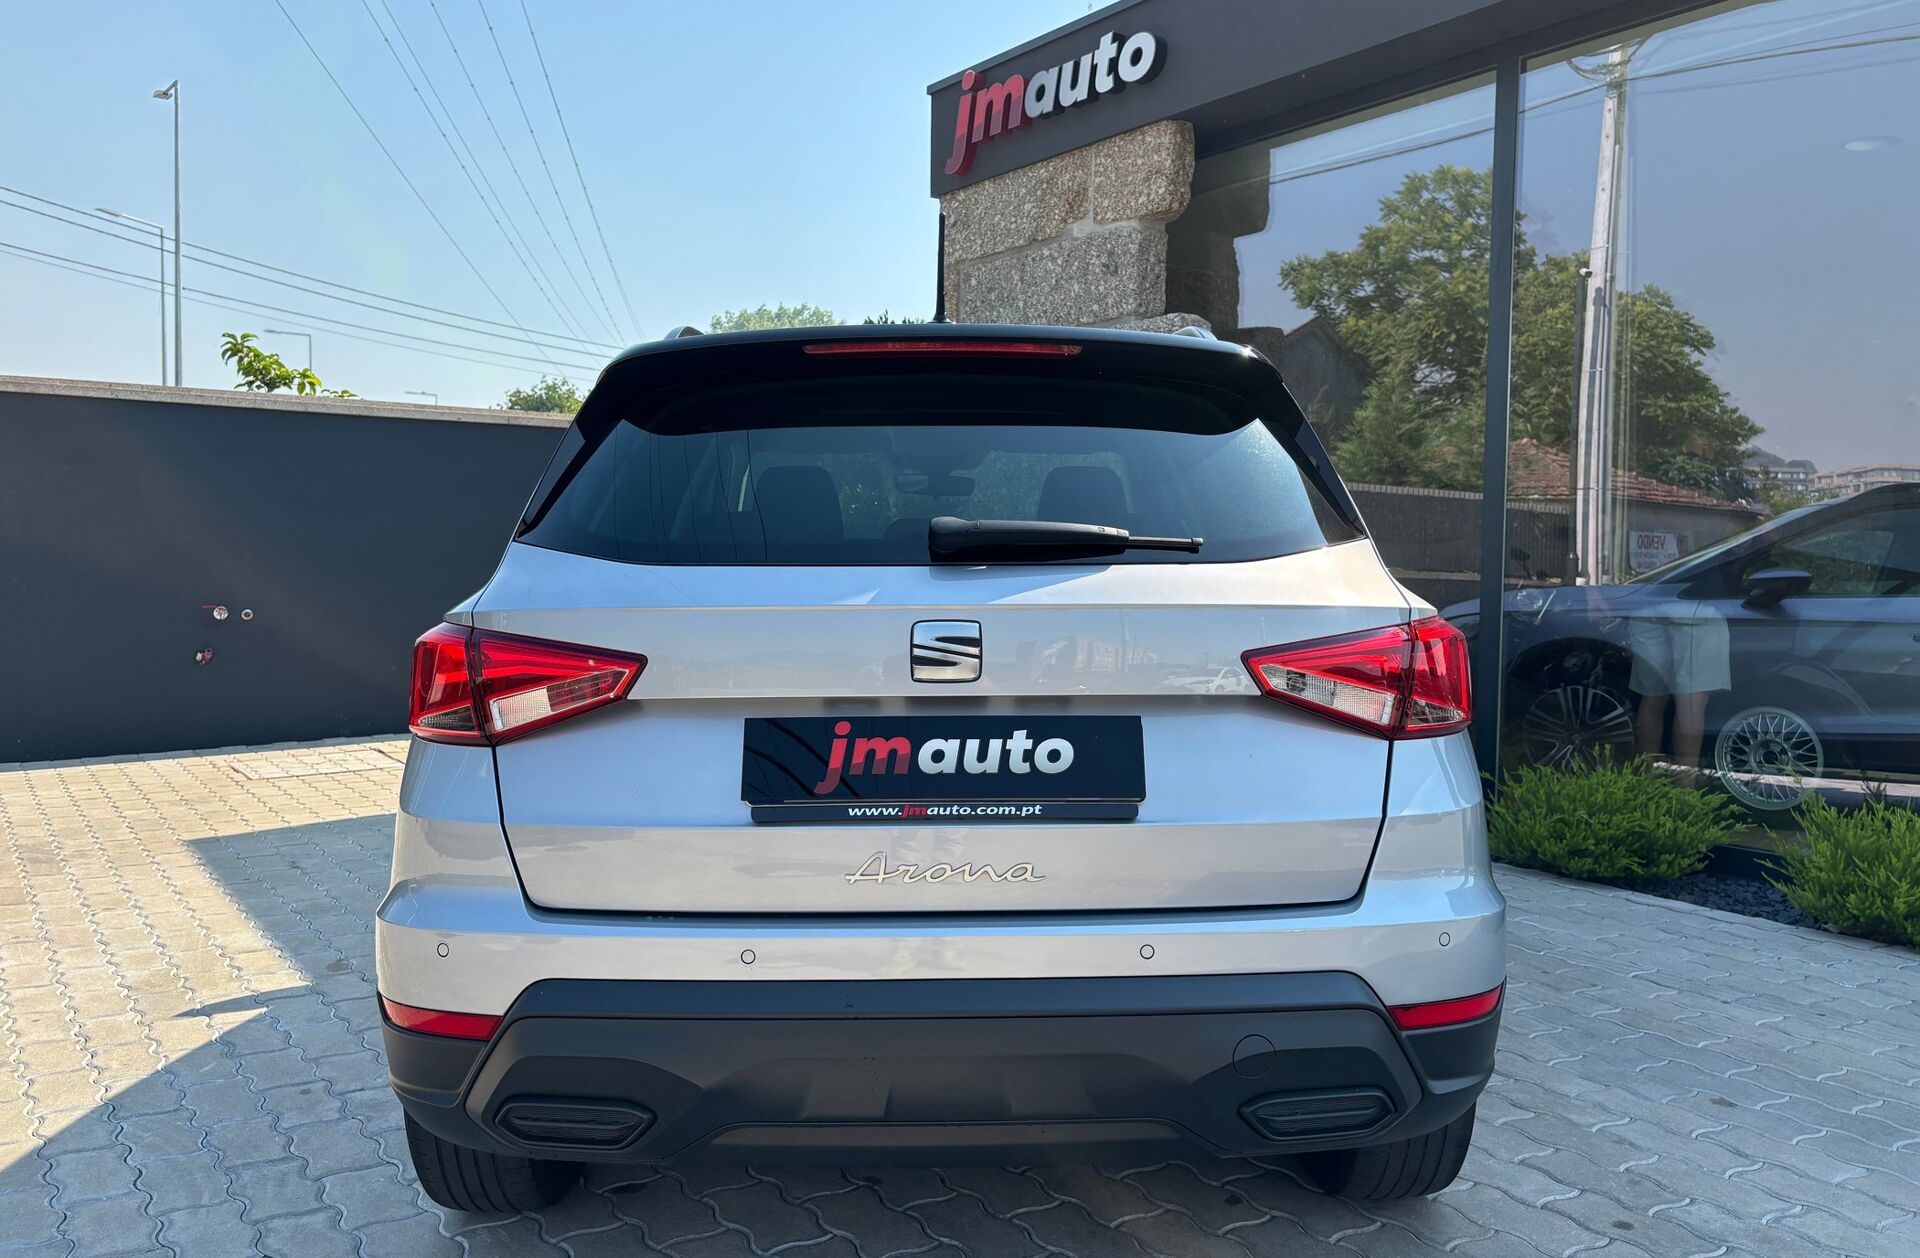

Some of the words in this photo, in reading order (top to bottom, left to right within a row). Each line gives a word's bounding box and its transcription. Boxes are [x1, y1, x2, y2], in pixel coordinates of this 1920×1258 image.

[944, 31, 1157, 175] jmauto
[848, 804, 1043, 817] www.jmauto.com.pt
[844, 851, 1046, 884] Arona
